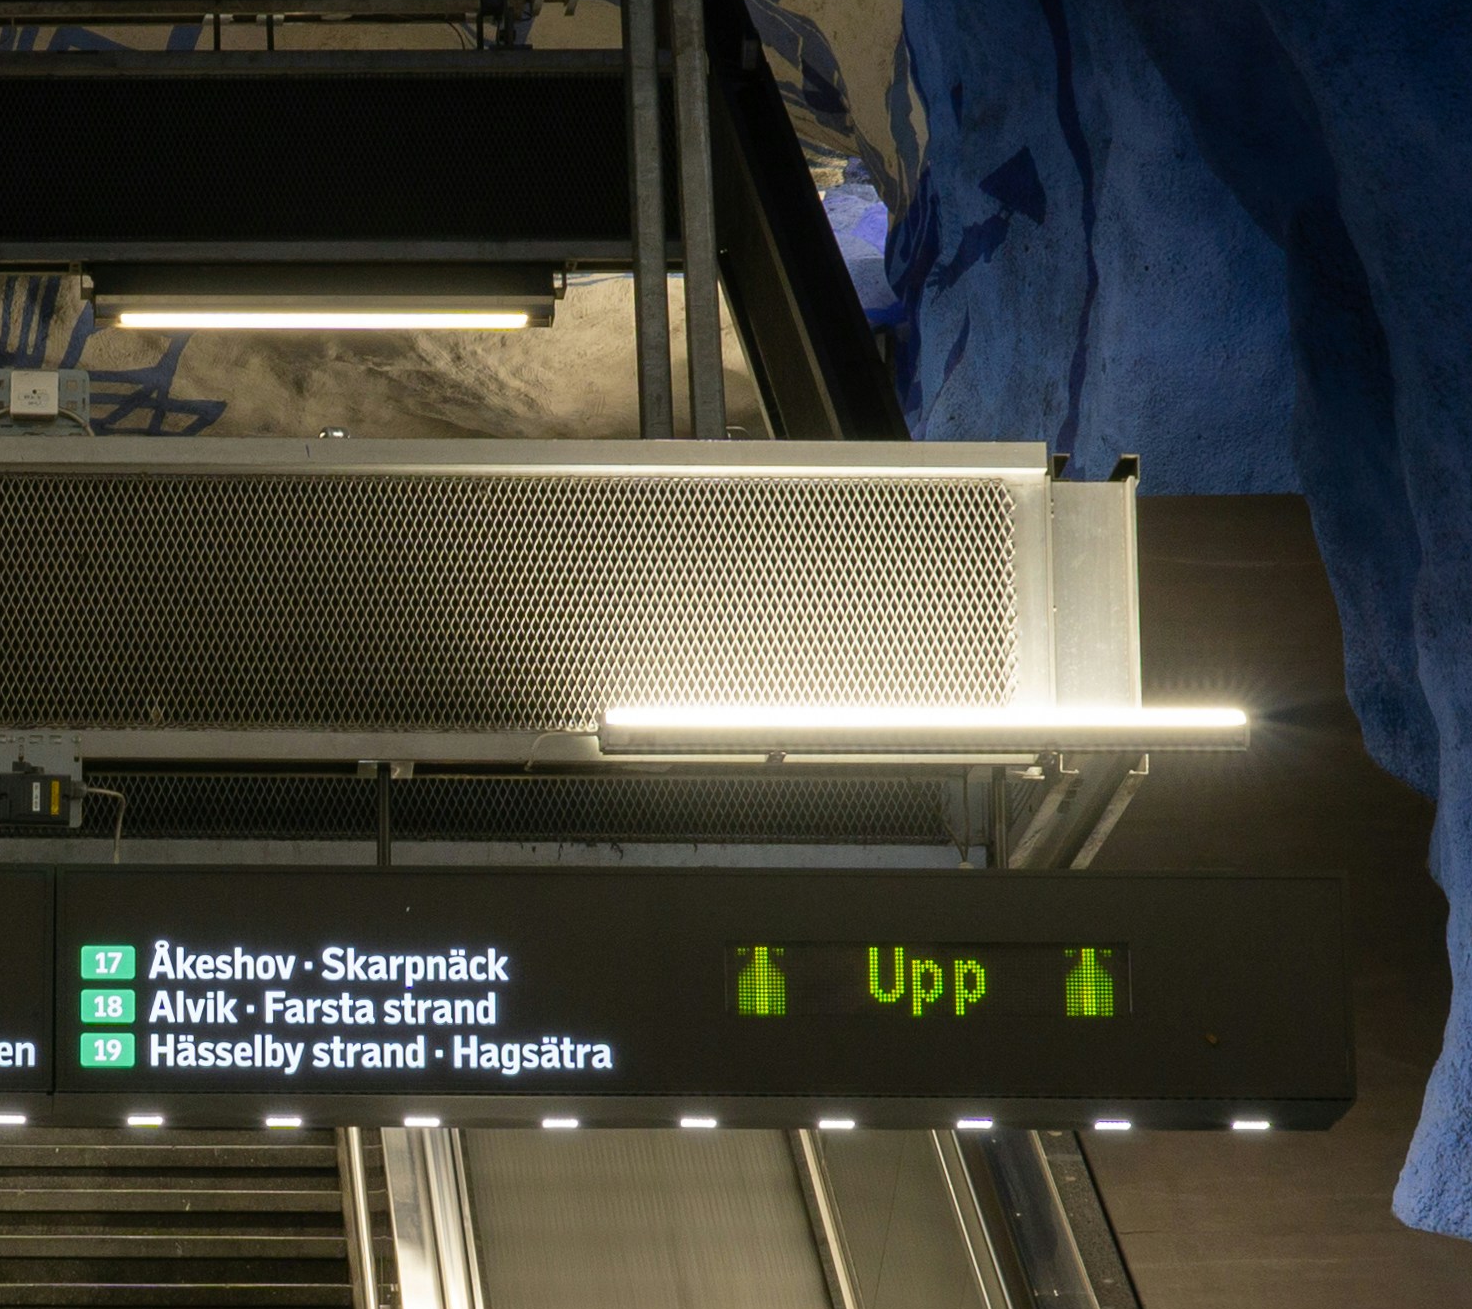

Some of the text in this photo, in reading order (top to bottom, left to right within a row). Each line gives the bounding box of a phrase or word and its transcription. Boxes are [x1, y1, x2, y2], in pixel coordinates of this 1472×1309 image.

[95, 940, 509, 988] 17 Åkeshov Skarpnäck
[868, 946, 986, 1016] Upp
[94, 990, 497, 1026] 18 Alvik Farsta strand
[94, 1033, 613, 1076] 19 Hässelby strand Hagsätra
